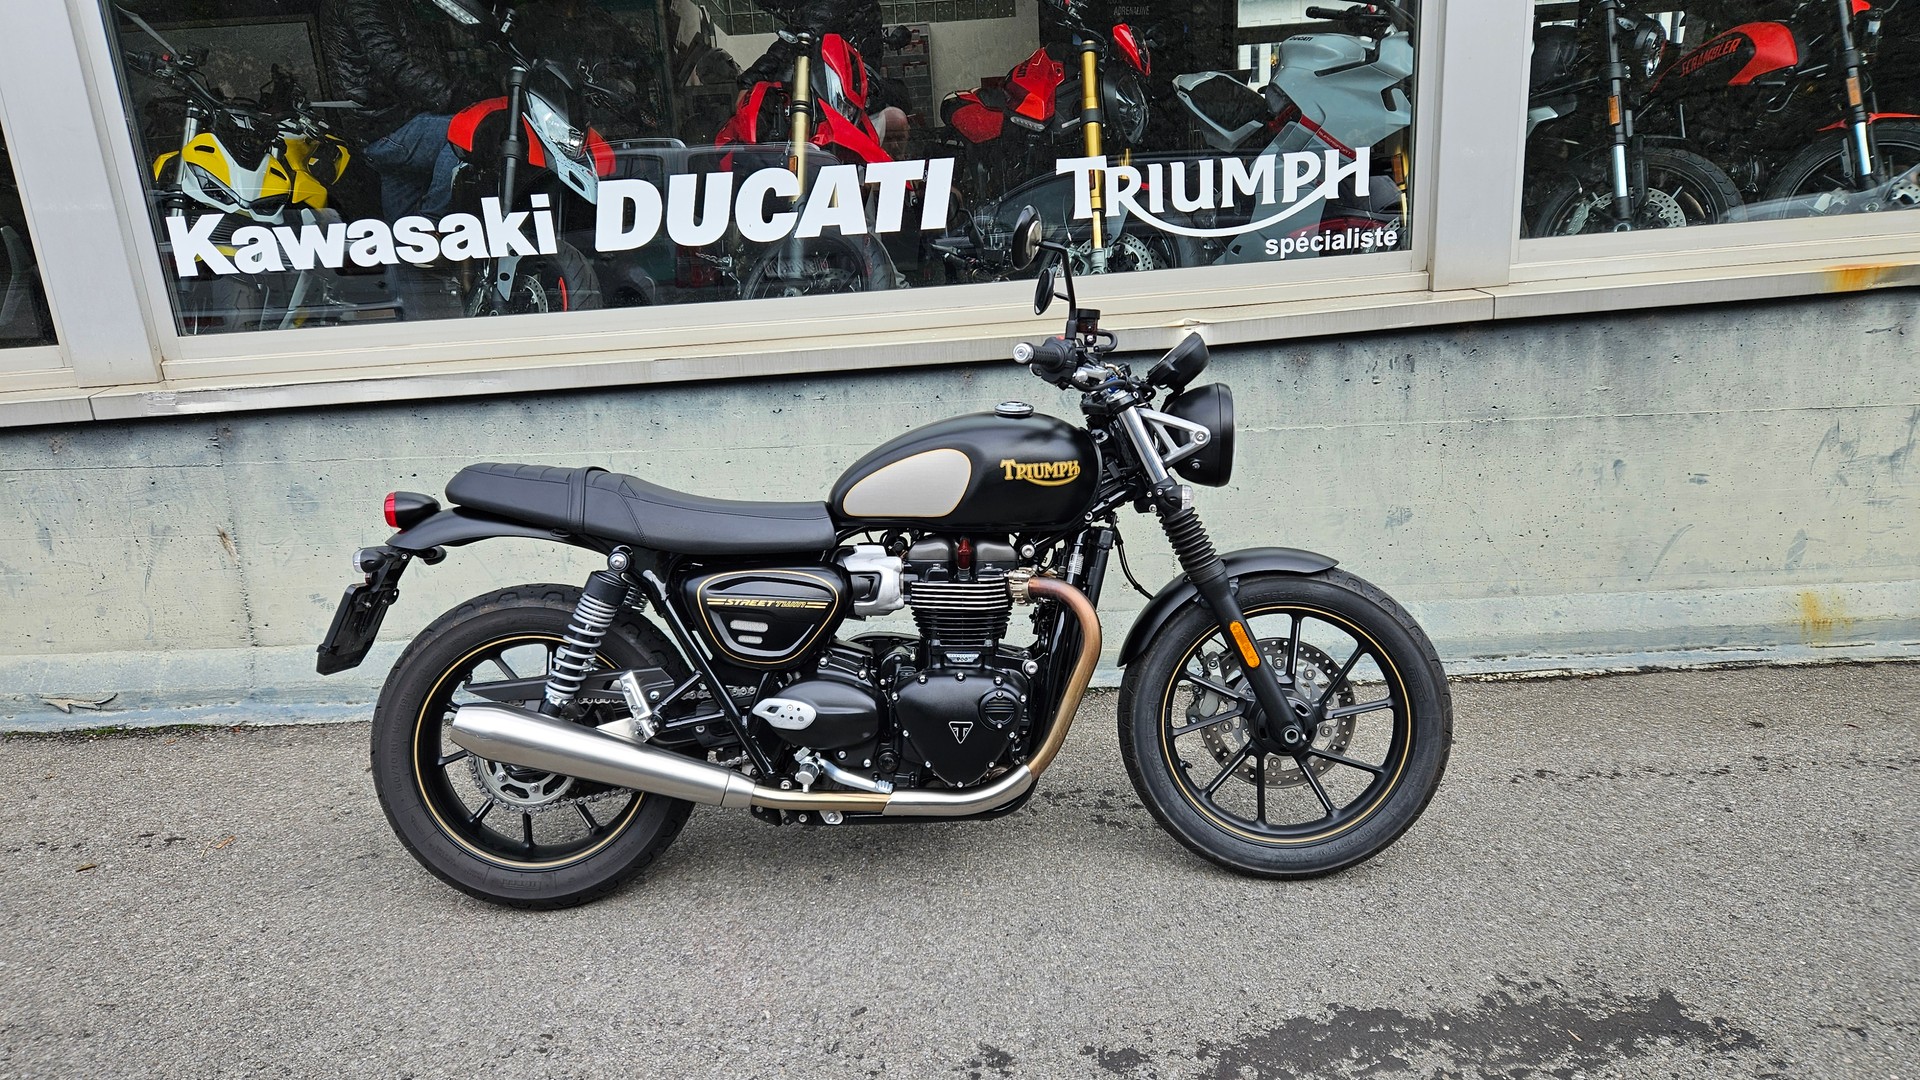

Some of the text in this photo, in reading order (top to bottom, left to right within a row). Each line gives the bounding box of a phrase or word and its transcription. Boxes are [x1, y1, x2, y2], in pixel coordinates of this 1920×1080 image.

[1679, 37, 1743, 78] SCRAMBLER
[595, 157, 955, 253] DUCATI
[1056, 146, 1371, 238] TRIUMPH
[166, 193, 558, 278] Kawasaki
[1264, 226, 1398, 259] spécialiste
[999, 458, 1081, 487] TRIUMPH
[725, 599, 776, 607] STREET
